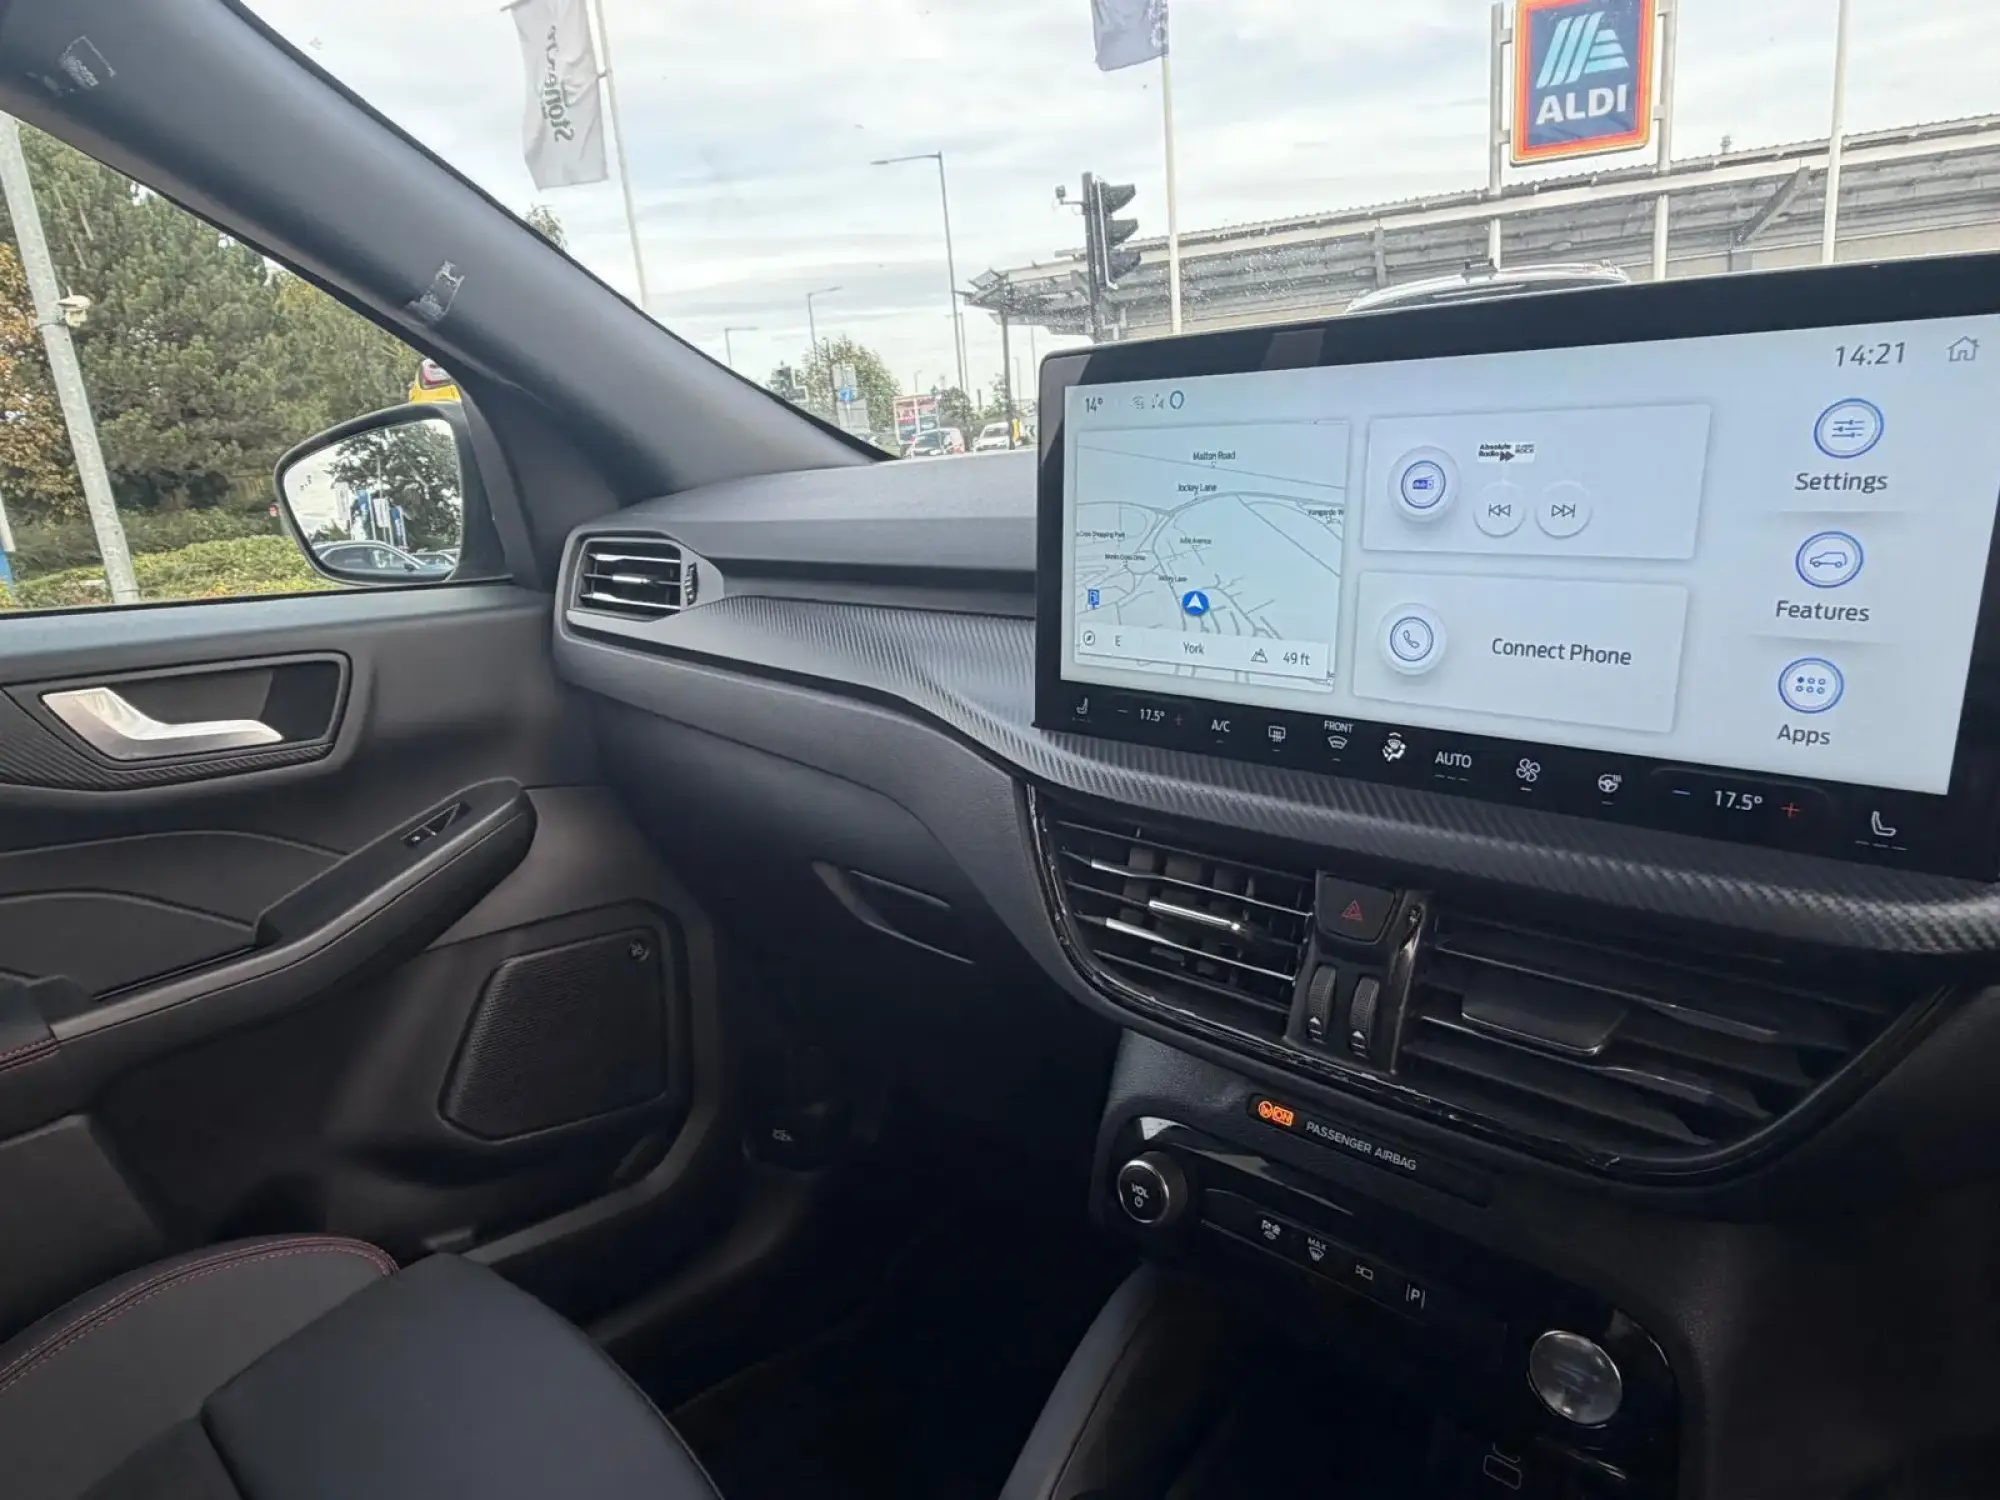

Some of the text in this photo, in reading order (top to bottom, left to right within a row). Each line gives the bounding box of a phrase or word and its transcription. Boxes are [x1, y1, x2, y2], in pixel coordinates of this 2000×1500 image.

[1536, 83, 1629, 125] ALDI
[1835, 341, 1905, 367] 14:21
[1218, 450, 1236, 460] Road
[1200, 483, 1217, 492] Lane
[1794, 472, 1888, 494] Settings
[1776, 600, 1870, 622] Features
[1114, 635, 1121, 647] E
[1183, 641, 1204, 655] York
[1283, 652, 1310, 666] 49 ft
[1492, 637, 1632, 666] Connect Phone
[1211, 719, 1231, 732] A/C
[1324, 719, 1354, 733] FRONT
[1777, 724, 1831, 747] Apps
[1435, 751, 1472, 768] AUTO
[1305, 1121, 1417, 1172] PASSENGER AIRBAG
[1131, 1182, 1149, 1199] VOL
